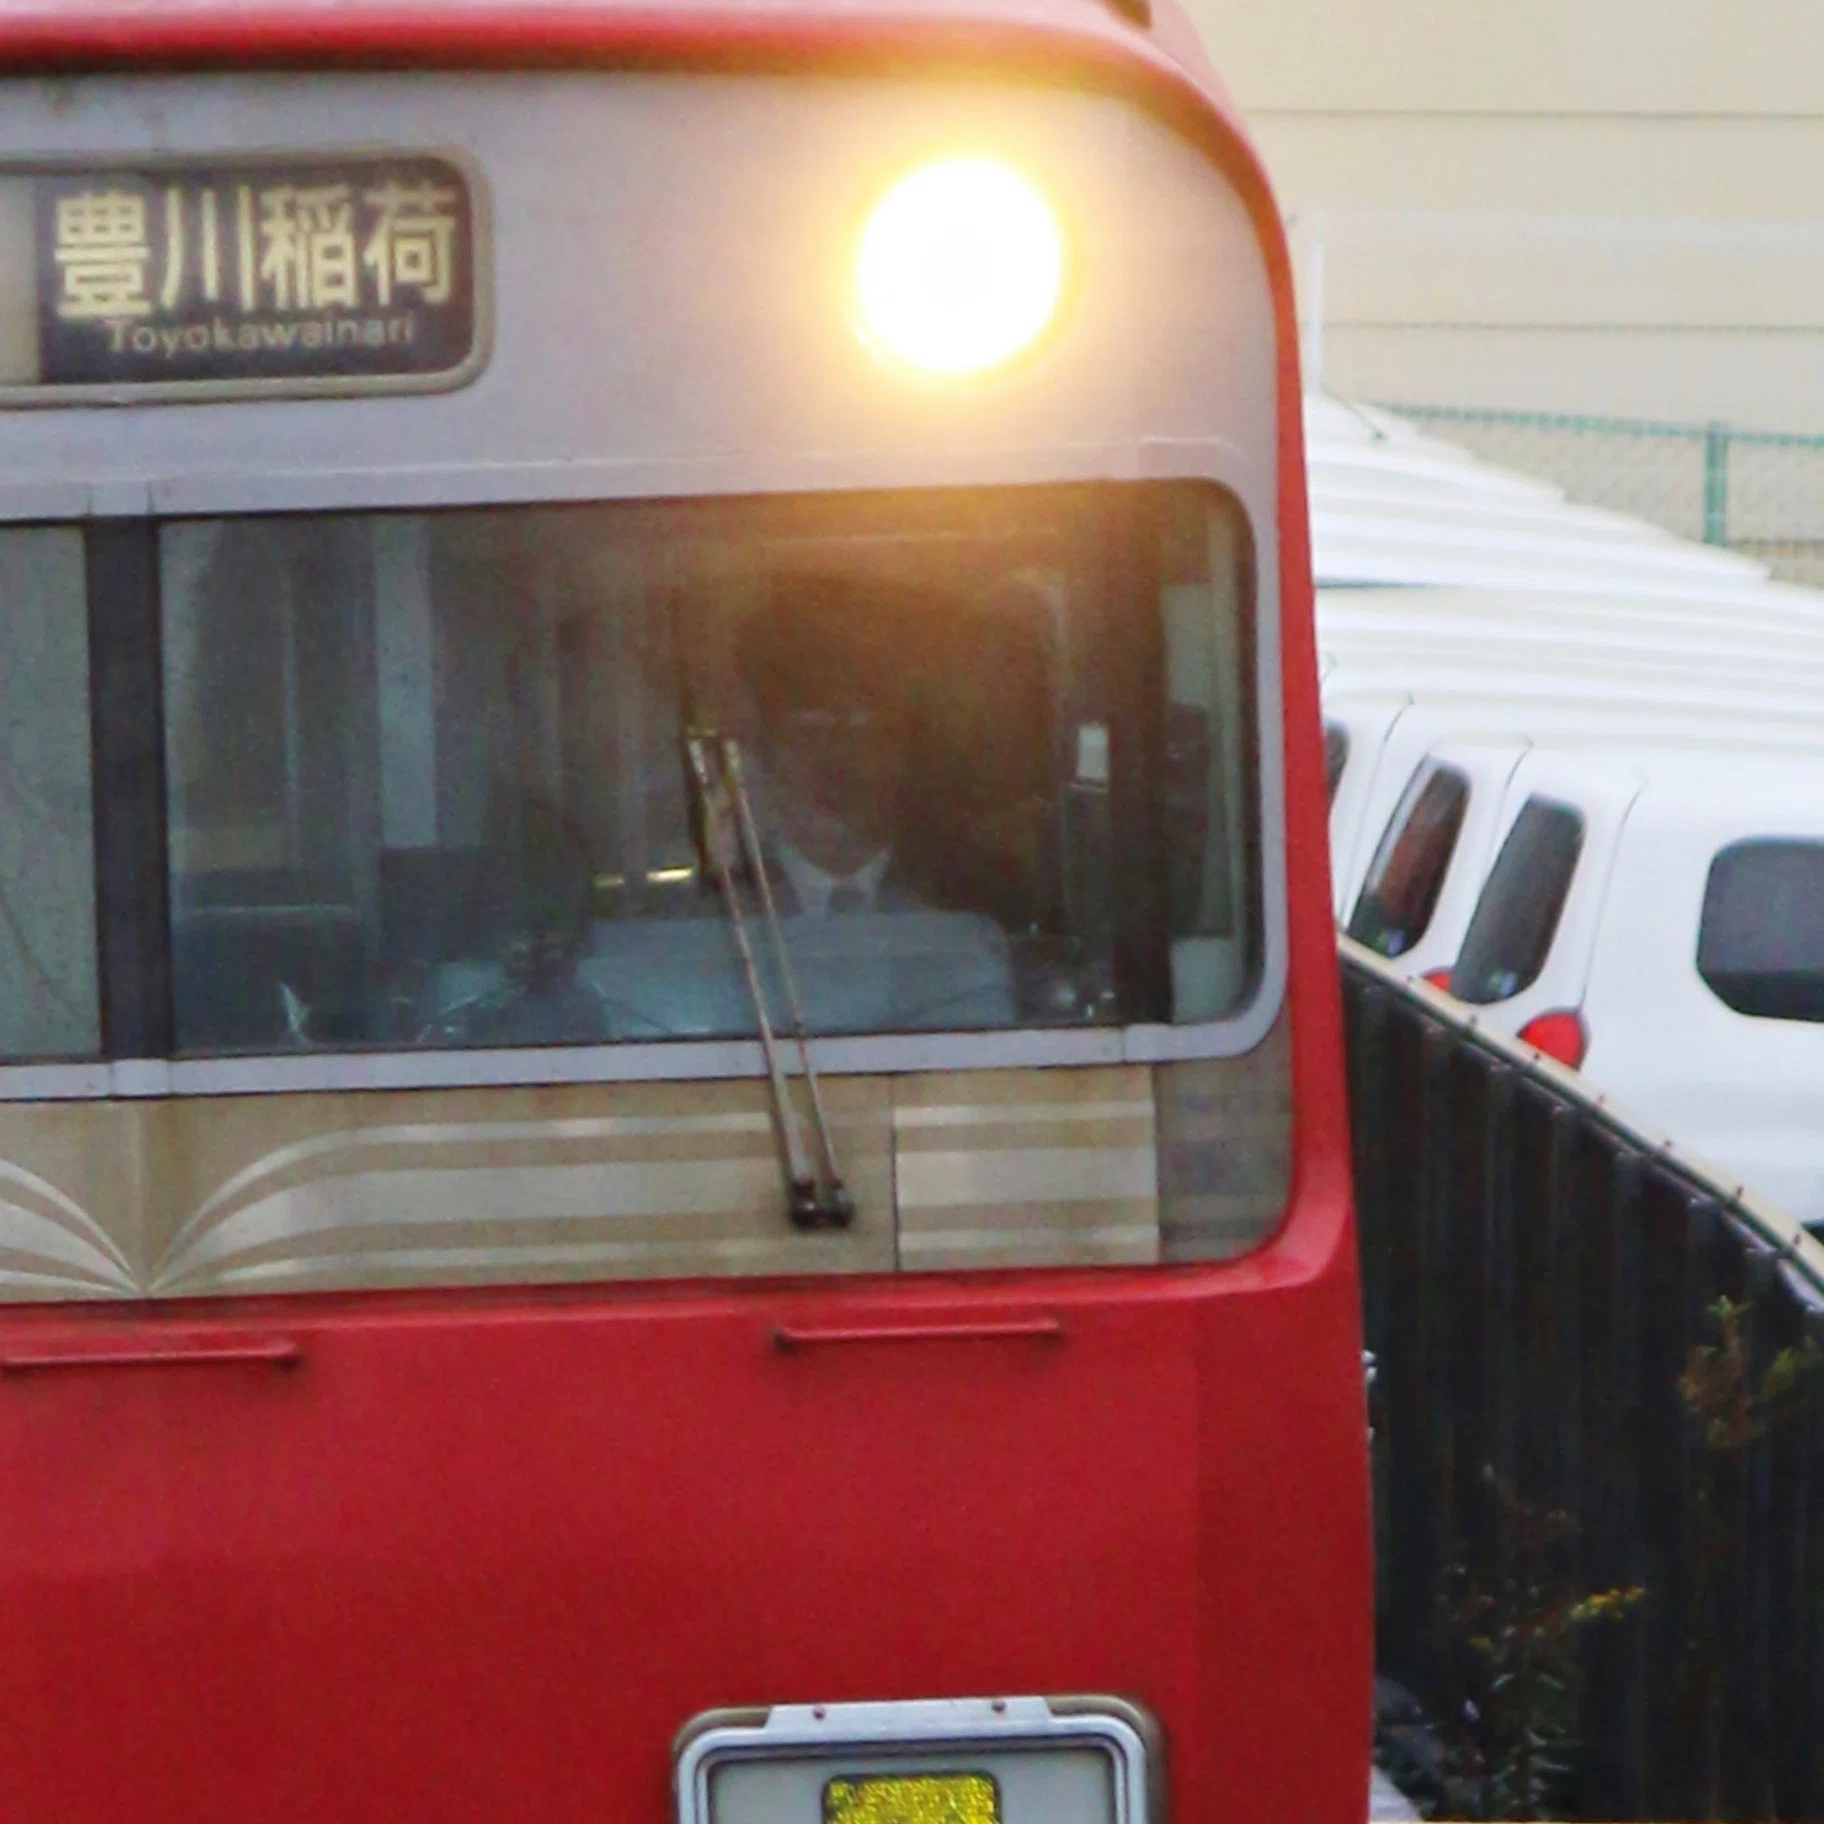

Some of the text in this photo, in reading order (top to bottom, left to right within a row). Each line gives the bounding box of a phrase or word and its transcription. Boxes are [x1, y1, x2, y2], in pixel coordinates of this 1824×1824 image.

[54, 182, 457, 321] 豊川稲荷
[106, 309, 416, 360] Toyokawainari
